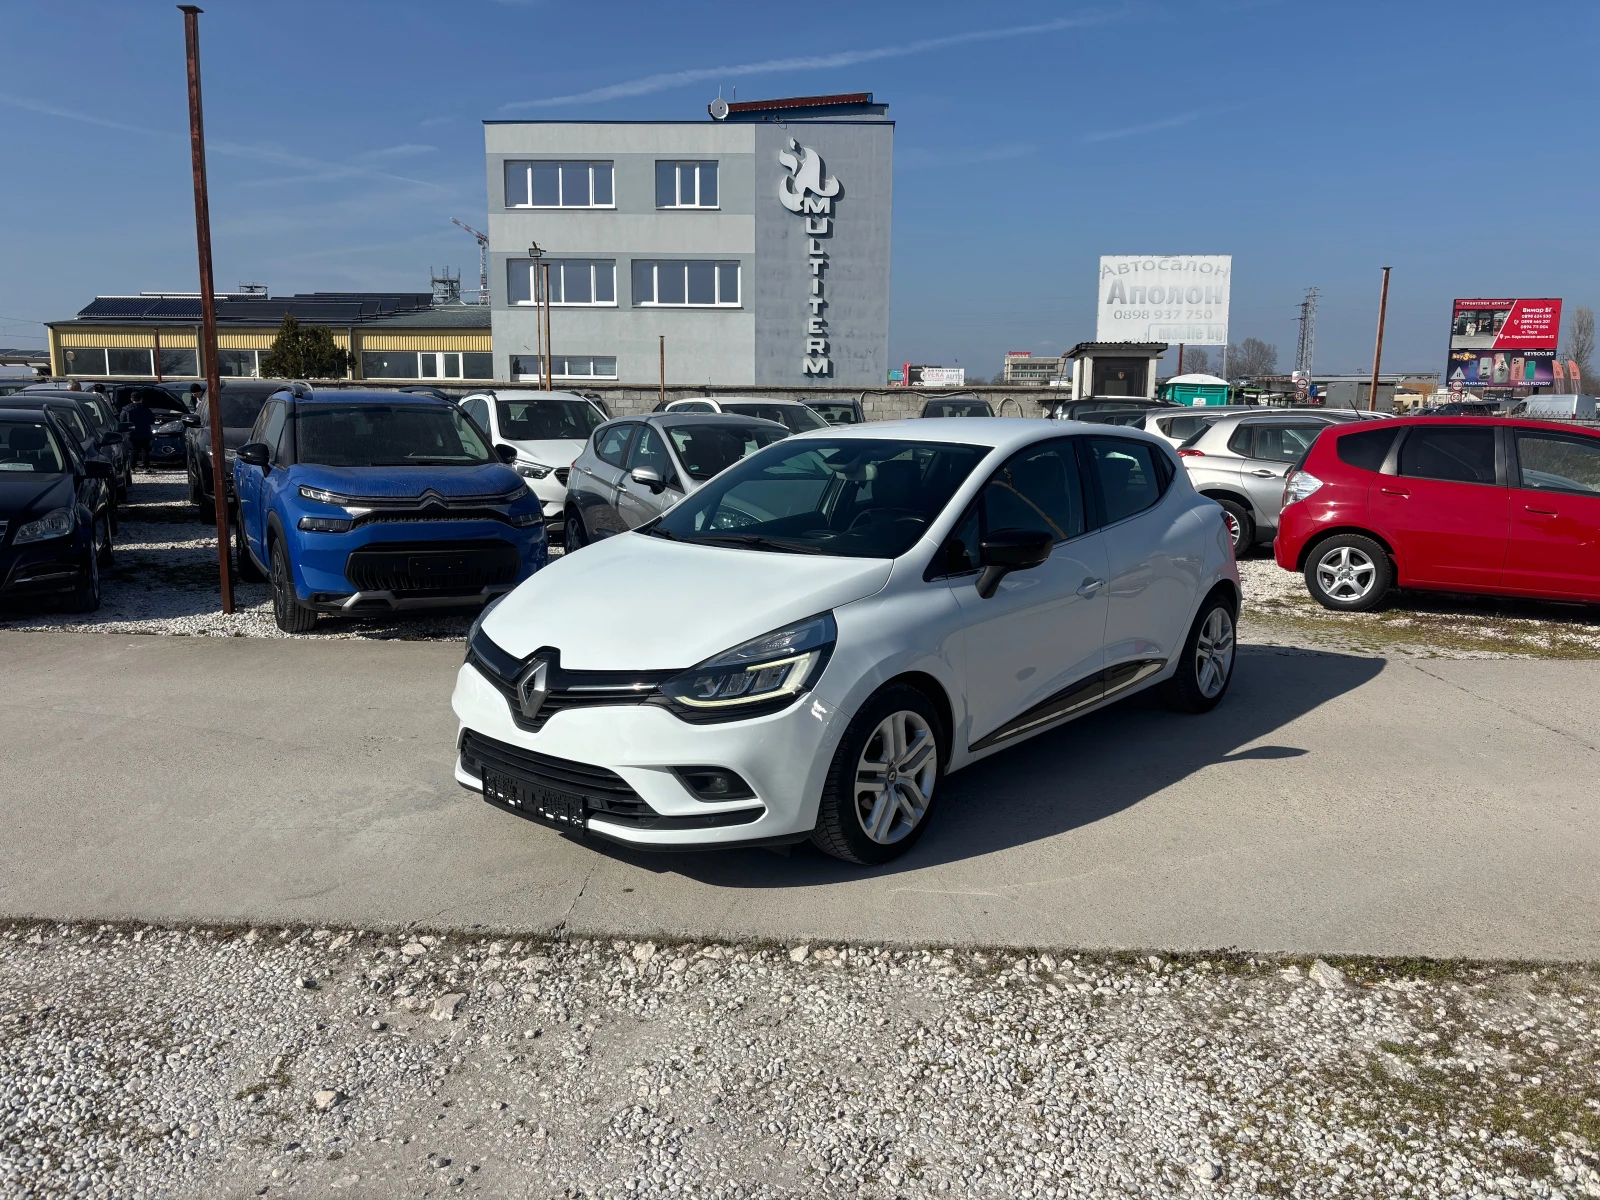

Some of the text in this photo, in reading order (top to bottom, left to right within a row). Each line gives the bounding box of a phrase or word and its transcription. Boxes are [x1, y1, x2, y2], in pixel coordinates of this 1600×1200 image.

[1101, 259, 1230, 280] Автосалон
[803, 197, 830, 374] MULTITERM
[1106, 278, 1224, 305] Аполон
[1113, 309, 1213, 320] 0898 937 750
